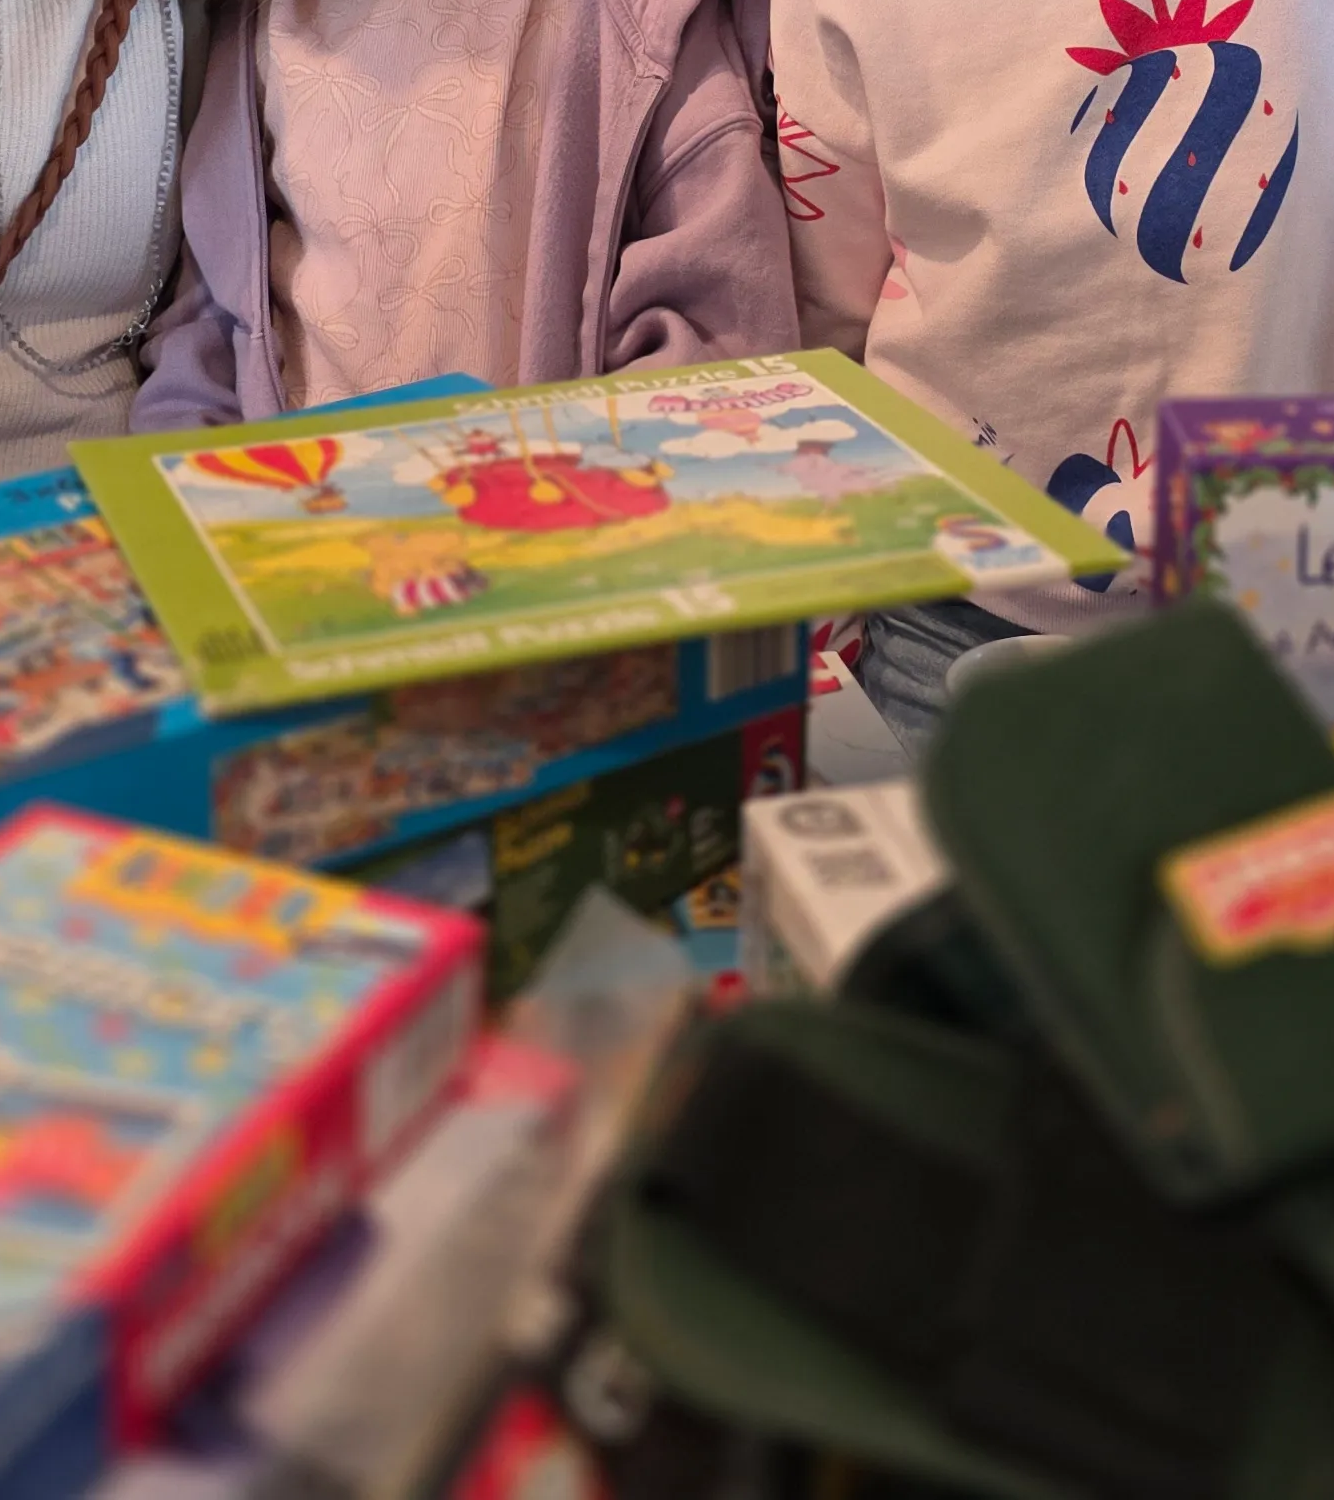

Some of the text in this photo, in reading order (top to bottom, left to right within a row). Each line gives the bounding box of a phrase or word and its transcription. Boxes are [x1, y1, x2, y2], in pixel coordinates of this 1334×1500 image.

[615, 367, 737, 394] Puzzle
[738, 354, 798, 378] 15
[663, 581, 736, 618] 15
